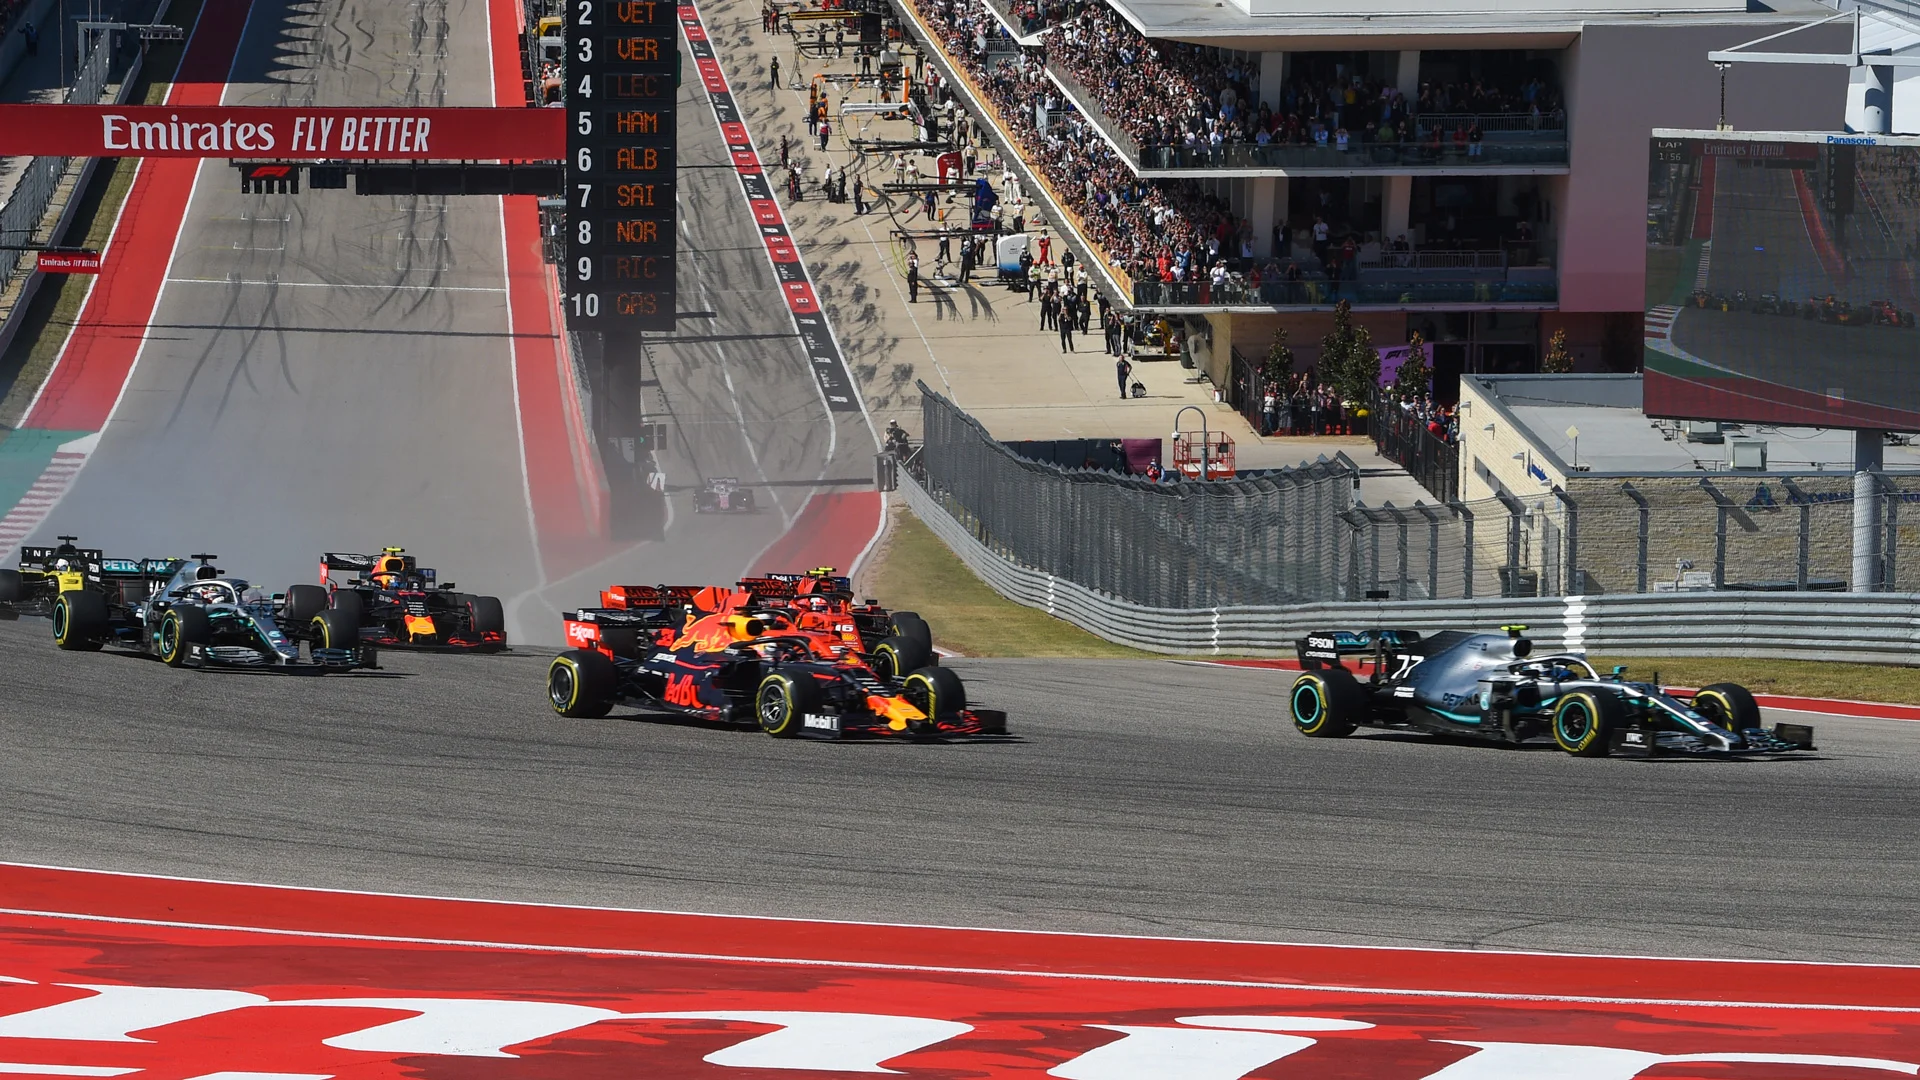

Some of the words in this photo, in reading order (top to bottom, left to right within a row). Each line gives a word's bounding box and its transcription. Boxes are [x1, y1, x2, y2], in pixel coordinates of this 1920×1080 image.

[578, 1, 592, 25] 2
[617, 2, 656, 24] VET
[578, 38, 592, 62] 3
[617, 38, 658, 61] VER
[578, 75, 592, 98] 4
[618, 75, 657, 97] LEC
[101, 114, 275, 151] Emirates
[291, 116, 335, 152] FLY
[340, 117, 431, 152] BETTER
[578, 111, 592, 135] 5
[617, 112, 657, 133] HAM
[1827, 136, 1876, 145] Panasonic
[578, 148, 592, 172] 6
[617, 148, 657, 170] ALB
[577, 184, 592, 207] 7
[617, 185, 655, 207] SAI
[578, 220, 592, 244] 8
[617, 221, 657, 242] NOR
[578, 257, 592, 281] 9
[617, 257, 656, 279] RIC
[571, 293, 599, 317] 10
[617, 294, 657, 315] GAS
[569, 623, 594, 642] Exxon
[1391, 655, 1425, 680] 77
[804, 714, 829, 730] Mobil
